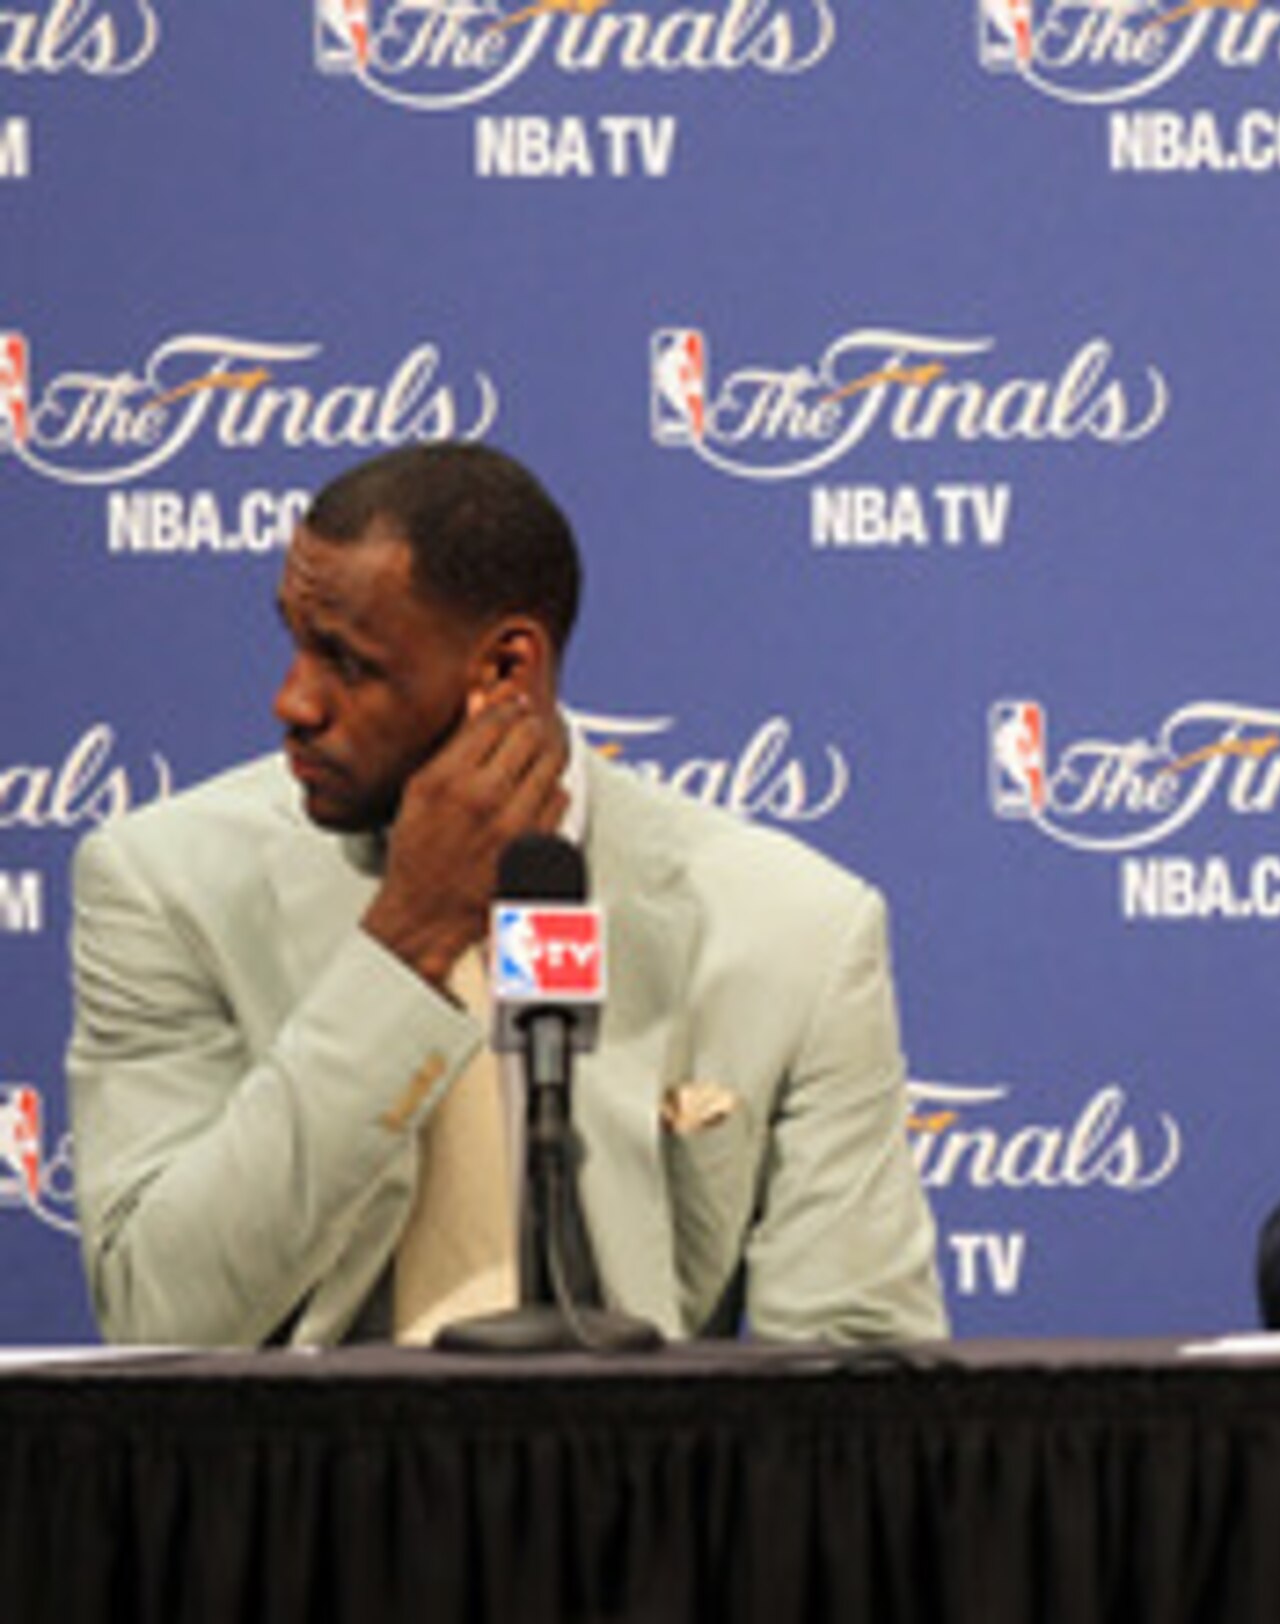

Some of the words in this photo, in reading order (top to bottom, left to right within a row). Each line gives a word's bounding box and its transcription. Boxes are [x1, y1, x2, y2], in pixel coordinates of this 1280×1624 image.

[363, 0, 835, 109] Finals
[378, 0, 512, 71] The
[1038, 0, 1172, 67] The
[475, 115, 594, 177] NBA
[598, 115, 677, 177] TV
[27, 335, 499, 485] Finals
[42, 372, 176, 447] The
[697, 330, 1169, 480] Finals
[712, 367, 846, 442] The
[107, 489, 312, 553] NBA.CO
[810, 485, 930, 547] NBA
[933, 483, 1011, 546] TV
[1047, 739, 1181, 814] The
[948, 1232, 1025, 1295] TV
